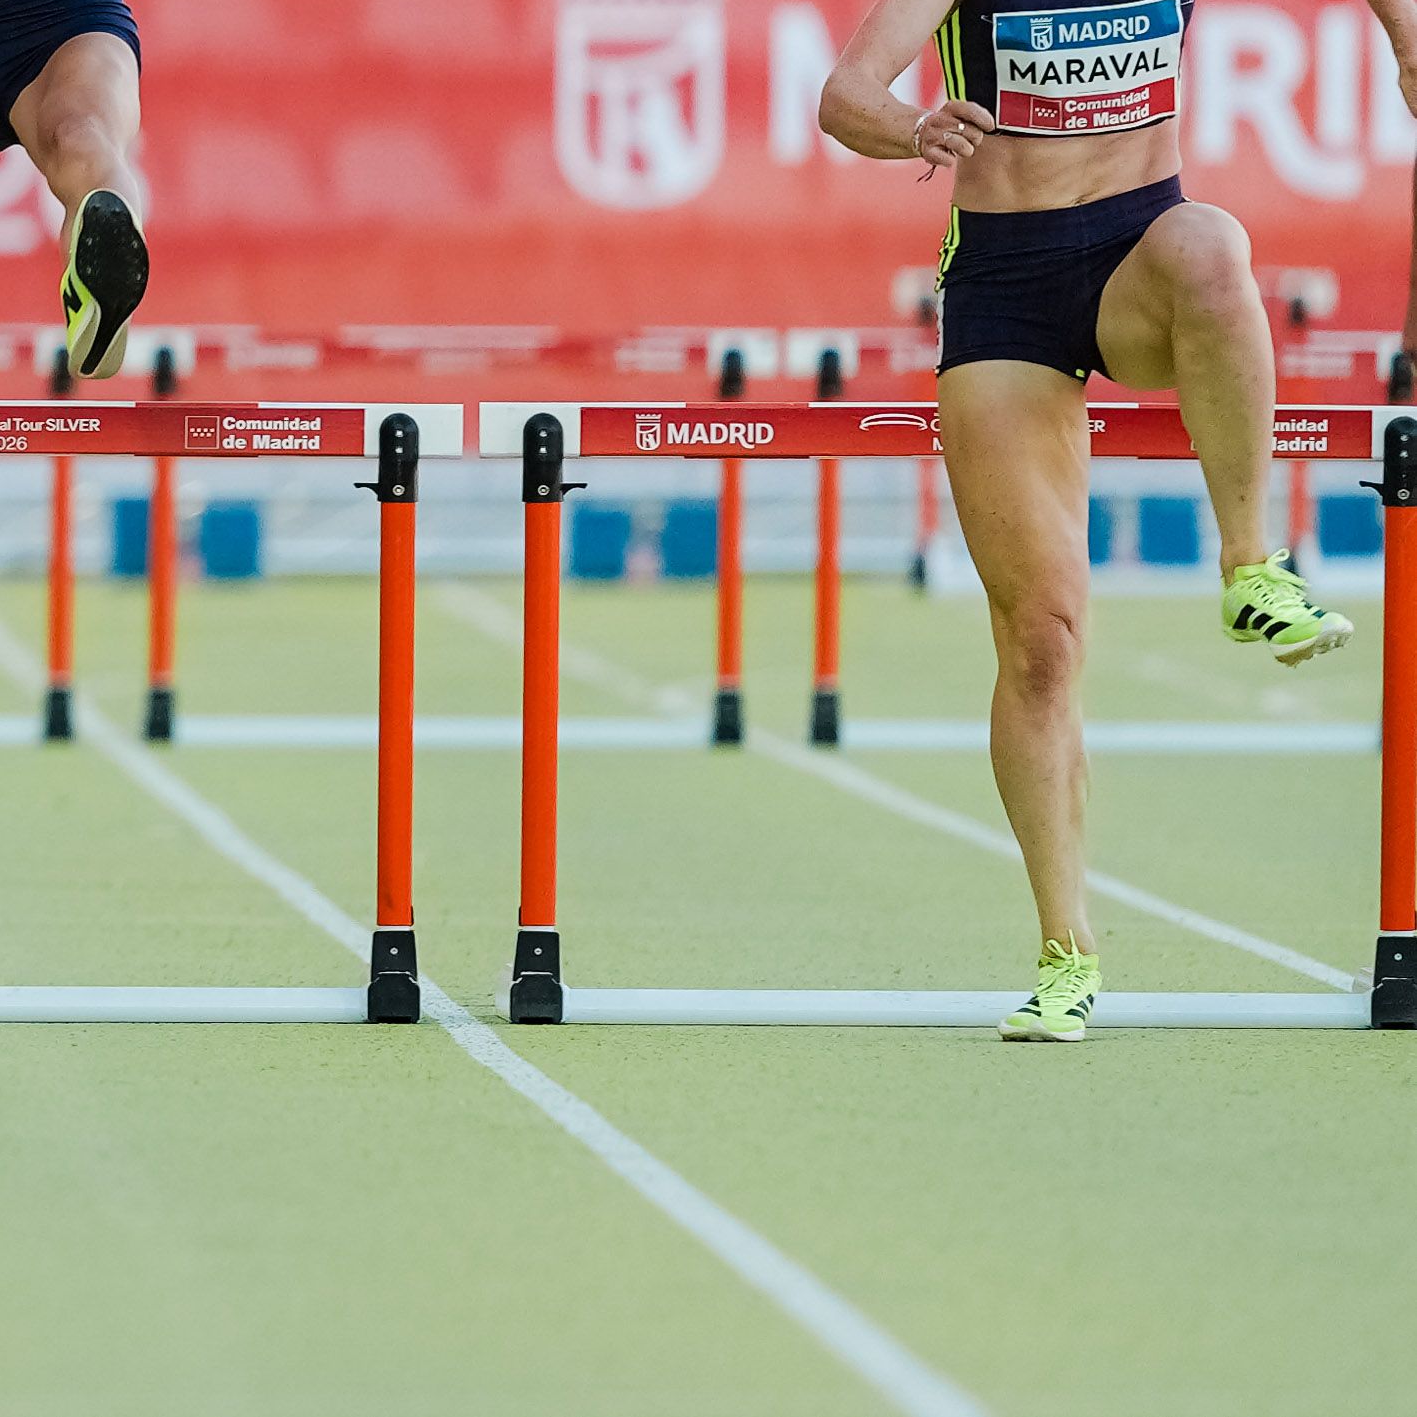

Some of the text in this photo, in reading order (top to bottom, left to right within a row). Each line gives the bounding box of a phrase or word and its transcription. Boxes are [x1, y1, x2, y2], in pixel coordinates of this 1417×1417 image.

[1058, 15, 1150, 43] MADRID
[1009, 47, 1168, 85] MARAVAL
[1064, 87, 1150, 113] Comunidad
[1065, 103, 1150, 129] de Madrid
[13, 418, 45, 432] Tour
[45, 418, 101, 432] SILVER
[222, 416, 321, 431] Comunidad
[1273, 418, 1328, 433] unidad
[222, 435, 321, 450] de Madrid
[667, 423, 774, 449] MADRID
[1272, 436, 1328, 452] adrid
